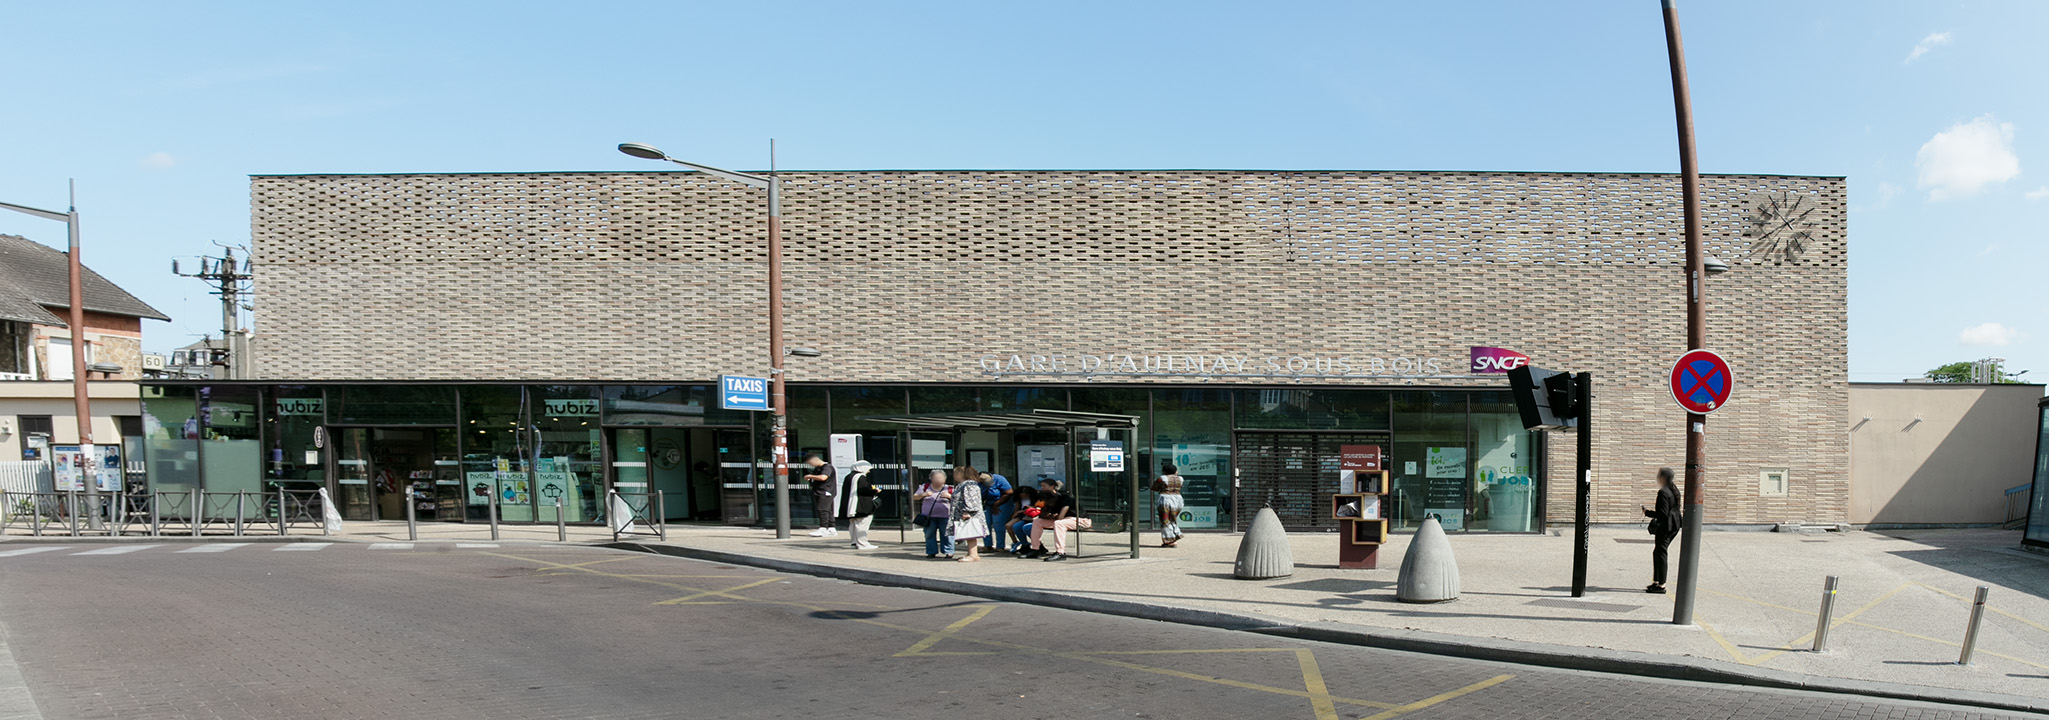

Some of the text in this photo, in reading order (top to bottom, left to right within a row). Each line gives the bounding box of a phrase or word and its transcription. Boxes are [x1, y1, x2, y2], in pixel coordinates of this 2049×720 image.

[145, 357, 161, 367] 60
[979, 354, 1067, 373] GARE
[1473, 356, 1527, 371] SNCF
[725, 378, 763, 392] TAXIS
[1499, 465, 1529, 475] CLEF
[1499, 476, 1529, 486] JOB
